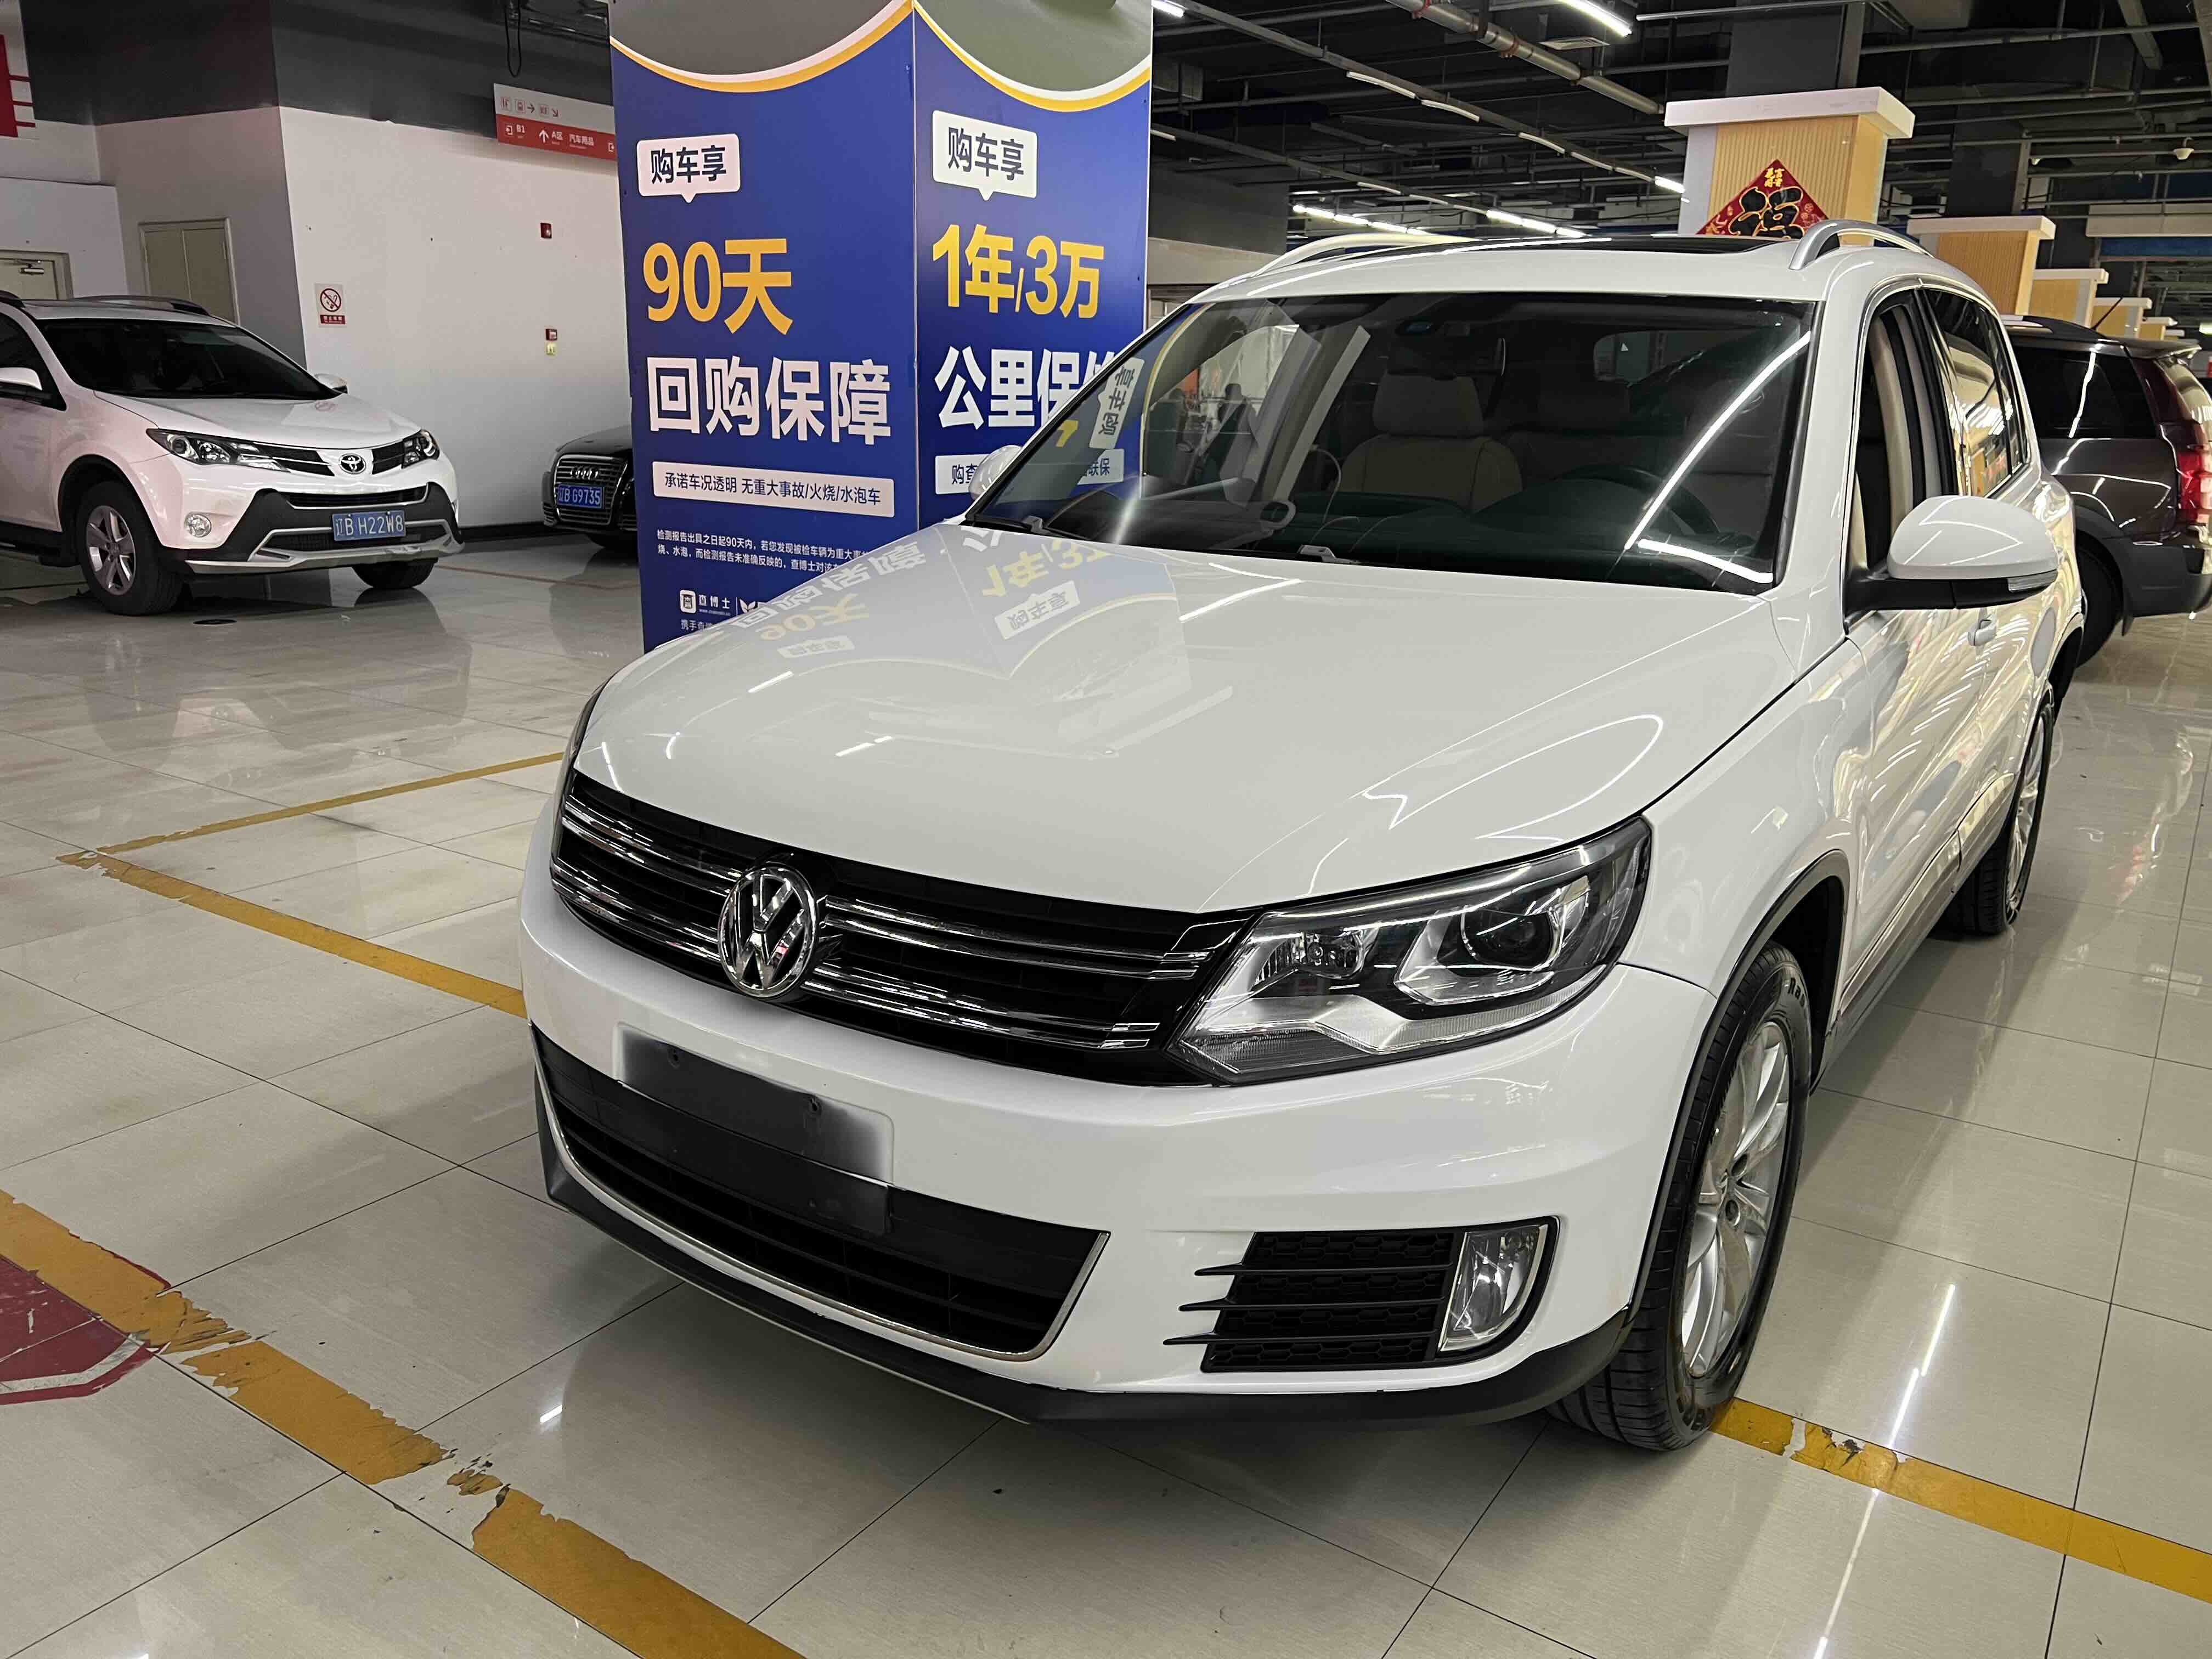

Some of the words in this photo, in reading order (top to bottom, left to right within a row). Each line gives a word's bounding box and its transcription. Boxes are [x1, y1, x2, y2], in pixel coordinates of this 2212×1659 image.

[516, 124, 525, 133] B1
[651, 144, 726, 184] 购车享
[947, 127, 1025, 182] 购车享
[643, 238, 793, 335] 90天
[933, 224, 1104, 318] 1年/3万
[646, 356, 891, 445] 回购保障
[665, 472, 737, 493] 承诺车况透明
[742, 478, 881, 505] 无重大事故/火烧/水泡车
[698, 594, 730, 609] 查博士
